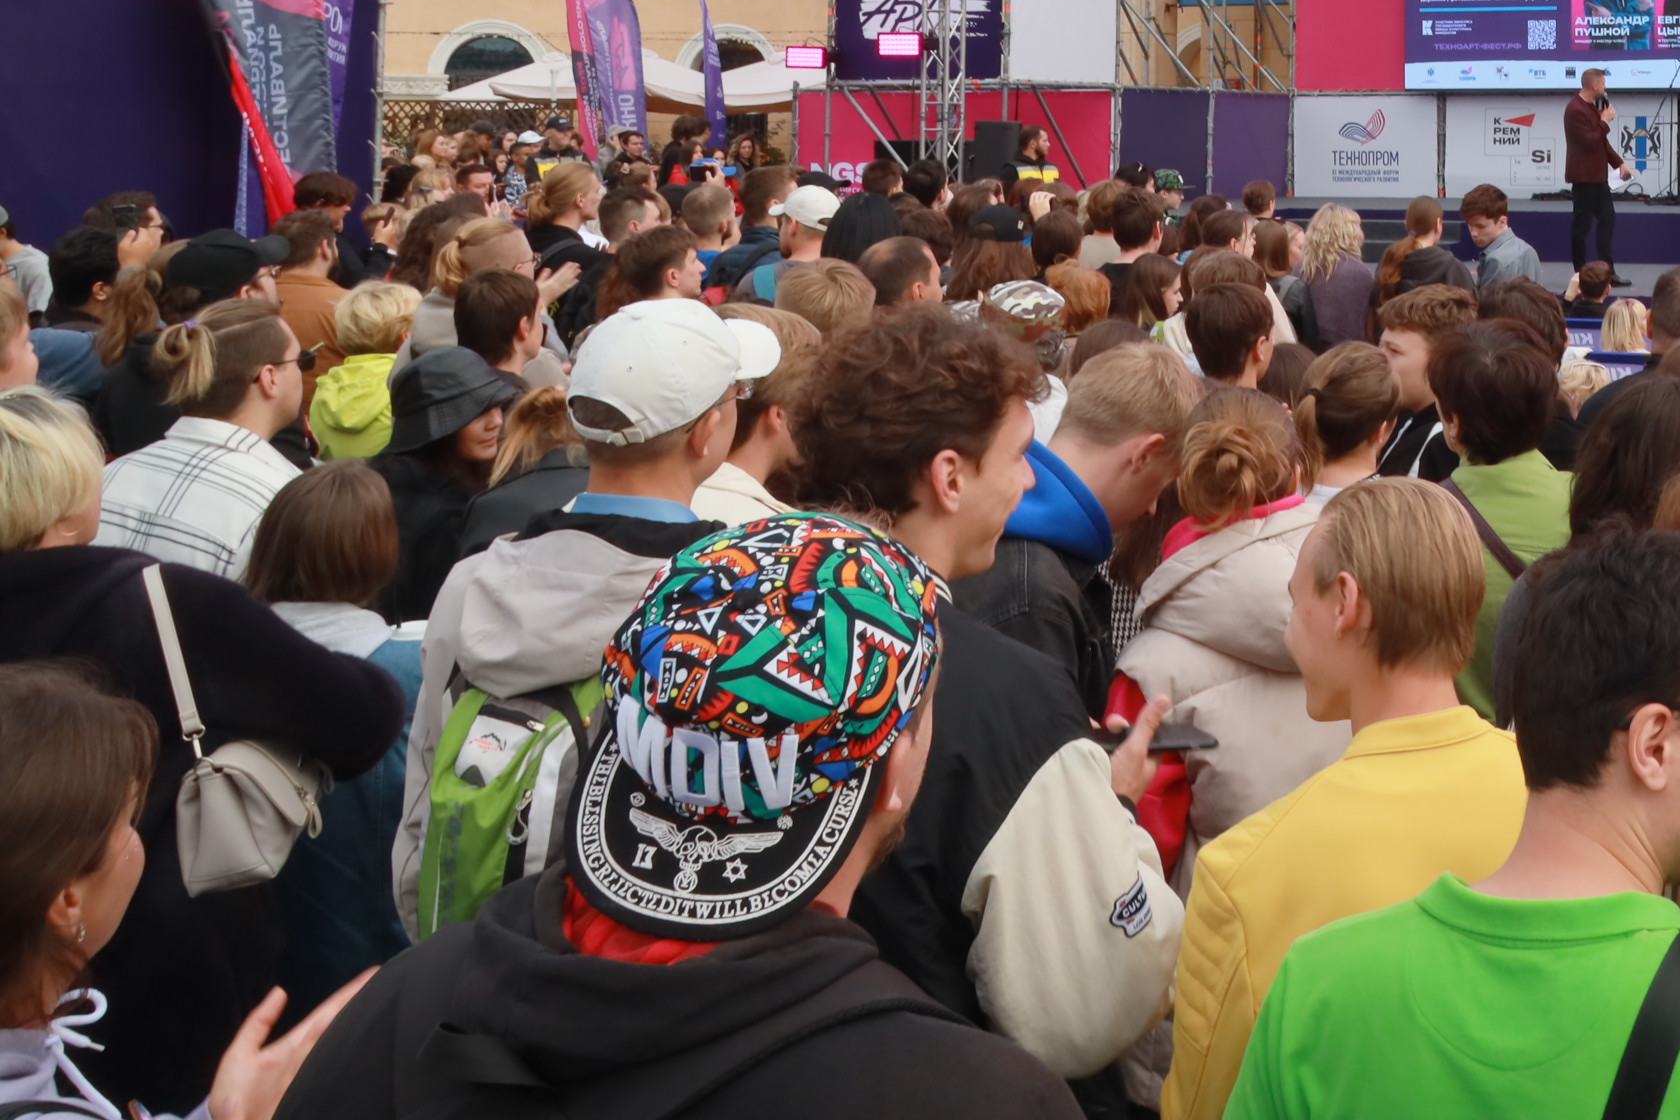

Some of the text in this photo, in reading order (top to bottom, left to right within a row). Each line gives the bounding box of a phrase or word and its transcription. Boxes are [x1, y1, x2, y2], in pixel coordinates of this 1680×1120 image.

[1575, 16, 1650, 26] АЛЕКСАНДР
[1575, 25, 1630, 37] ПУШНОЙ
[1493, 127, 1520, 136] РЕМ
[1493, 135, 1520, 146] НИЙ
[1332, 150, 1399, 167] ТЕХНОПРОМ
[1531, 149, 1551, 164] Si
